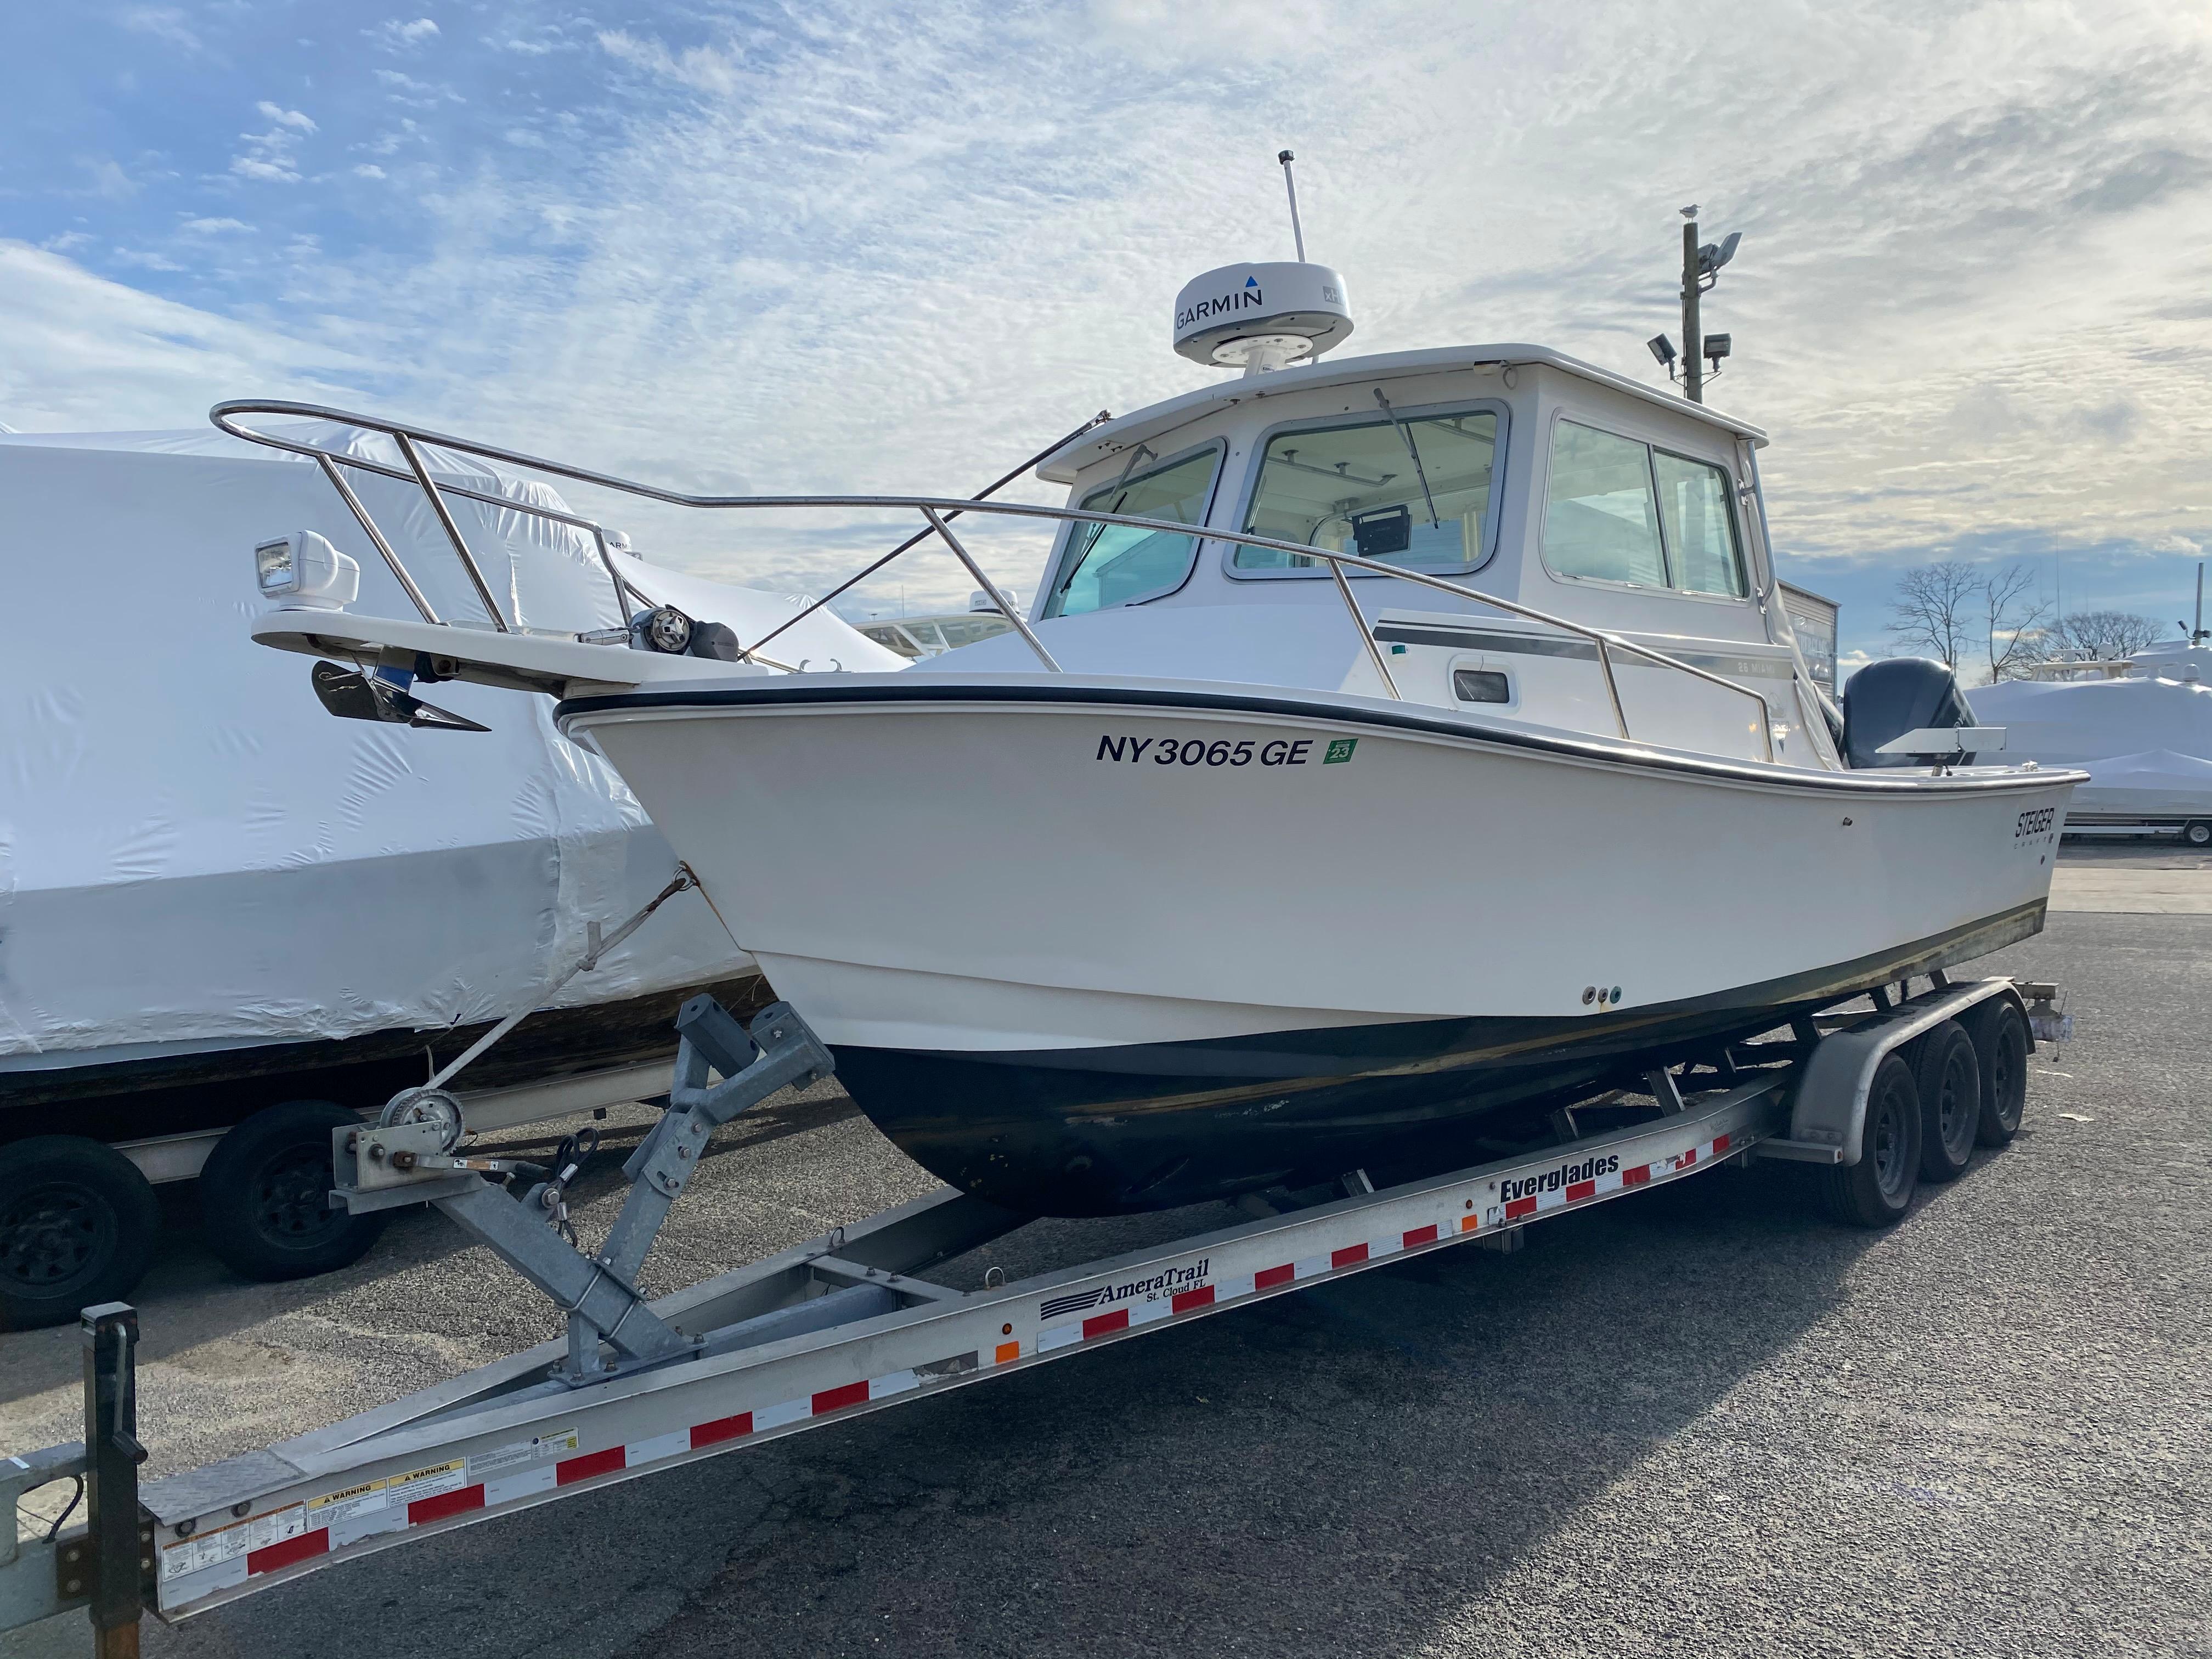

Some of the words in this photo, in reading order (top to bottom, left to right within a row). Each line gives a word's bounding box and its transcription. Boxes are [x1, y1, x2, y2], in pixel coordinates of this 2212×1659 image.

[1177, 290, 1262, 329] GARMIN
[1325, 289, 1344, 305] xH
[610, 541, 631, 550] ARMI
[1097, 735, 1154, 763] NY
[1154, 738, 1256, 766] 3065
[1261, 740, 1314, 766] GE
[2015, 808, 2055, 838] STEIGER
[1500, 1154, 1619, 1204] Everglades
[1098, 1258, 1210, 1305] AmeraTrail
[1146, 1292, 1159, 1303] St.
[1163, 1285, 1189, 1298] Cloud
[1193, 1278, 1206, 1288] FL
[413, 1464, 450, 1480] WARNING
[332, 1485, 371, 1501] WARNING
